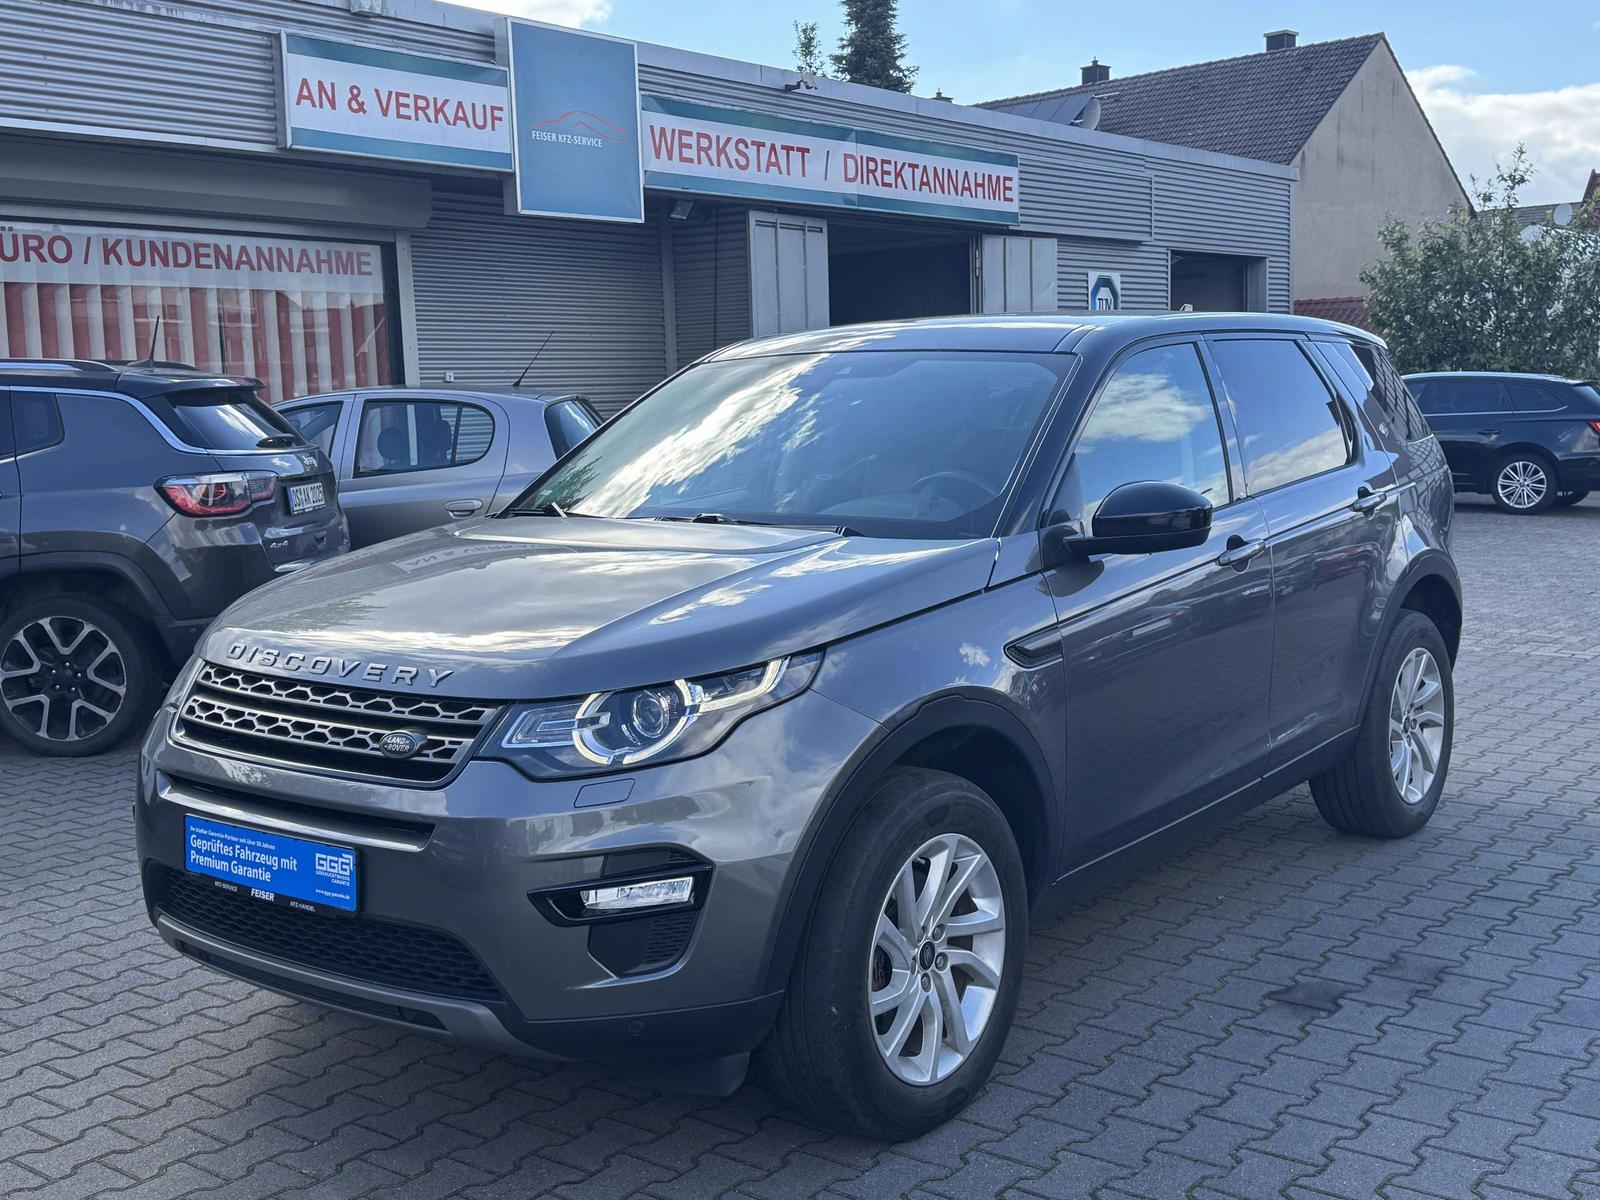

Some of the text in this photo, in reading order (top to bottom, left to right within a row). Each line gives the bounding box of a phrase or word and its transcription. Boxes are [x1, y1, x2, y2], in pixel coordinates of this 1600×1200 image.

[295, 77, 504, 132] AN & VERKAUF
[531, 130, 603, 148] FEISER KFZ-SERVICE
[649, 124, 1014, 203] WERKSTATT / DIREKTANNAHME
[83, 236, 92, 265] /
[103, 236, 373, 277] KUNDENANNAHME
[226, 642, 454, 688] DISCOVERY
[386, 744, 410, 752] ROVER
[387, 736, 406, 744] LAND
[190, 834, 297, 871] Geprüftes Fahrzeug mit
[190, 850, 271, 882] Premium Garantie
[315, 852, 351, 876] GGG
[250, 888, 275, 902] FEISER
